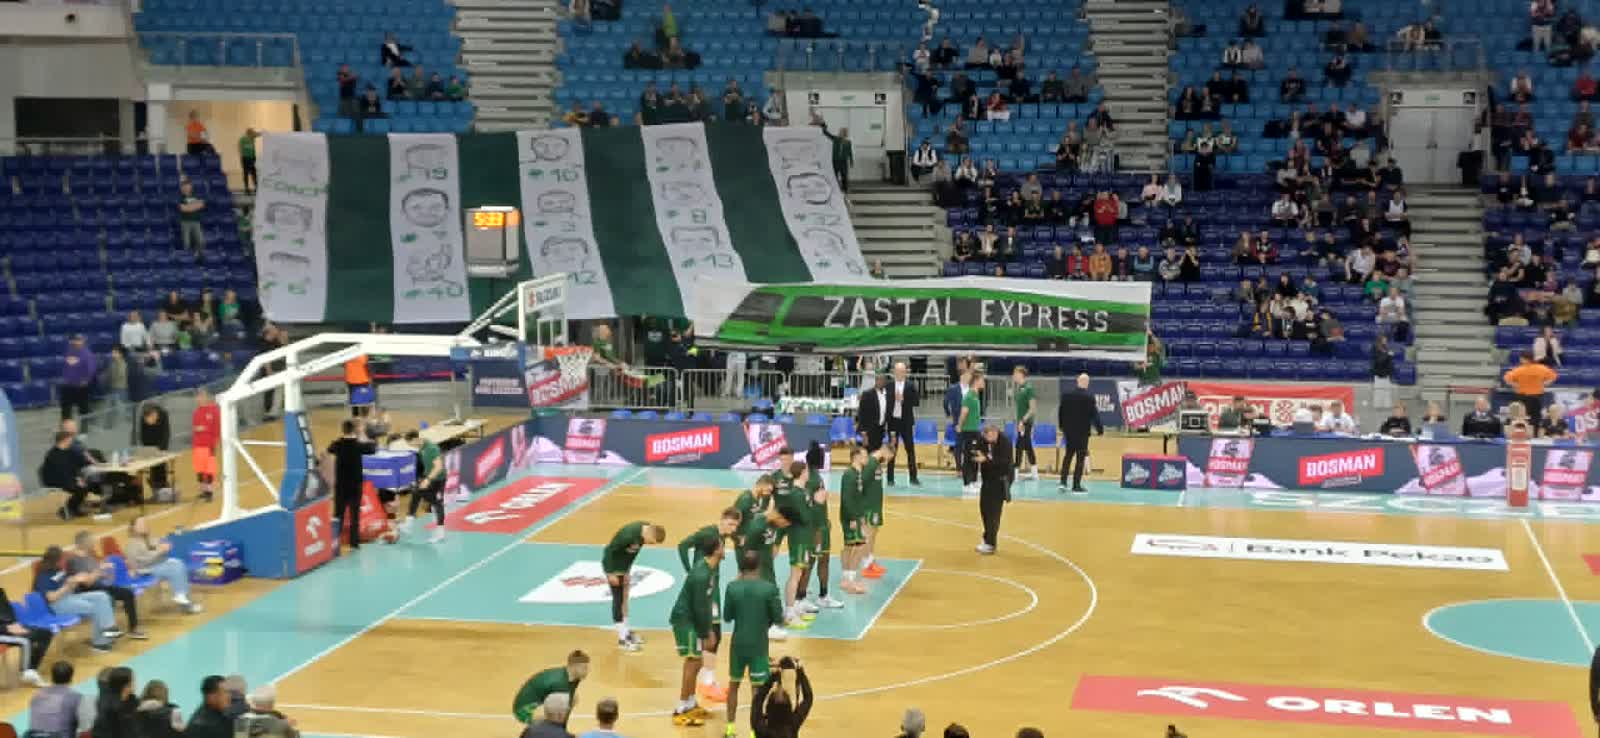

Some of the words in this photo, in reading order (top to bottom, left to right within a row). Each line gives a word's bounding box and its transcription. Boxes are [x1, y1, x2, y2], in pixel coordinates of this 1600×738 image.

[823, 295, 959, 329] ZASTAL
[980, 298, 1110, 333] EXPRESS
[1126, 382, 1186, 424] BOSMAN
[652, 431, 713, 455] BOSMAN
[1305, 453, 1377, 478] BOSMAN
[1246, 542, 1350, 558] Bank
[1363, 549, 1495, 565] Pekao
[1266, 694, 1513, 726] ORLEN
